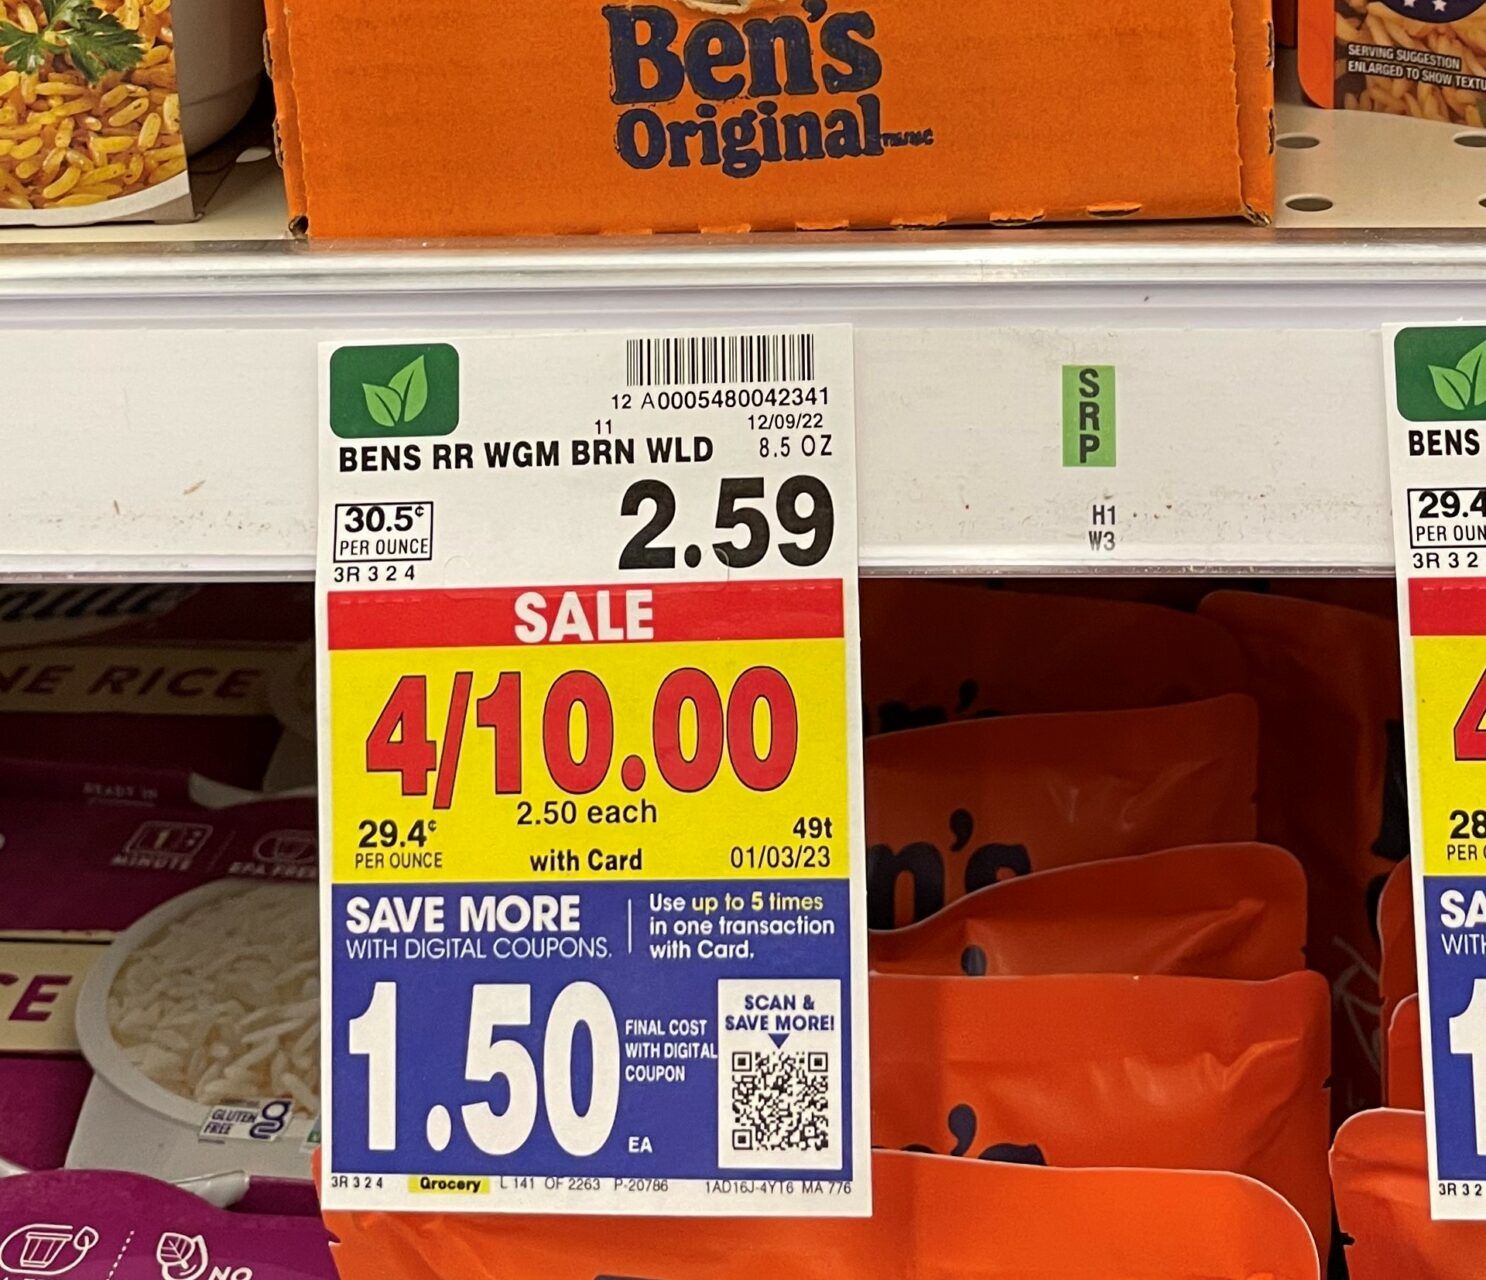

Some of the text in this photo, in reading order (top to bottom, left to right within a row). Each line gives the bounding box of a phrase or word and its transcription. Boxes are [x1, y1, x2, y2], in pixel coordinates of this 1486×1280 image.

[1347, 43, 1461, 70] SERVING SUGGESTION
[1347, 60, 1404, 77] ENLARGED
[1406, 67, 1420, 80] TO
[1422, 70, 1453, 85] SHOW
[616, 93, 884, 179] Original
[612, 386, 830, 411] 12 A0005480042341
[595, 413, 824, 434] 11 12/09/22
[759, 437, 791, 458] 8.5
[1409, 429, 1480, 456] BENS
[339, 437, 714, 472] BENS RR WGM BRN WLD
[618, 474, 835, 571] 2.59
[1092, 505, 1116, 525] H1
[1089, 531, 1116, 551] W3
[1416, 526, 1447, 542] PER
[340, 537, 429, 556] PER OUNCE
[1412, 552, 1478, 569] 3R 3 2
[334, 564, 415, 582] 3R 3 2 4
[514, 589, 654, 644] SALE
[88, 665, 262, 698] RICE
[365, 665, 799, 810] 4/10.00
[516, 798, 658, 825] 2.50 each
[792, 816, 833, 840] 49t
[355, 851, 443, 870] PER OUNCE
[530, 847, 643, 872] with Card
[730, 845, 832, 869] 01/03/23
[1447, 844, 1478, 861] PER
[346, 895, 580, 934] SAVE MORE
[649, 893, 824, 917] Use up to 5 times
[649, 916, 835, 935] in one transaction
[346, 936, 613, 960] WITH DIGITAL COUPONS.
[649, 940, 755, 959] with Card.
[744, 994, 815, 1011] SCAN &
[625, 1020, 707, 1035] FINAL COST
[724, 1014, 835, 1033] SAVE MORE!
[625, 1042, 718, 1059] WITH DIGITAL
[348, 980, 652, 1157] 1.50 EA
[625, 1066, 685, 1082] COUPON
[203, 1109, 258, 1135] GLUTEN FREE
[514, 1177, 534, 1189] 141
[545, 1176, 564, 1190] OF
[568, 1177, 600, 1191] 2263
[614, 1178, 668, 1192] P-20786
[802, 1180, 824, 1194] MA
[828, 1180, 852, 1195] 776
